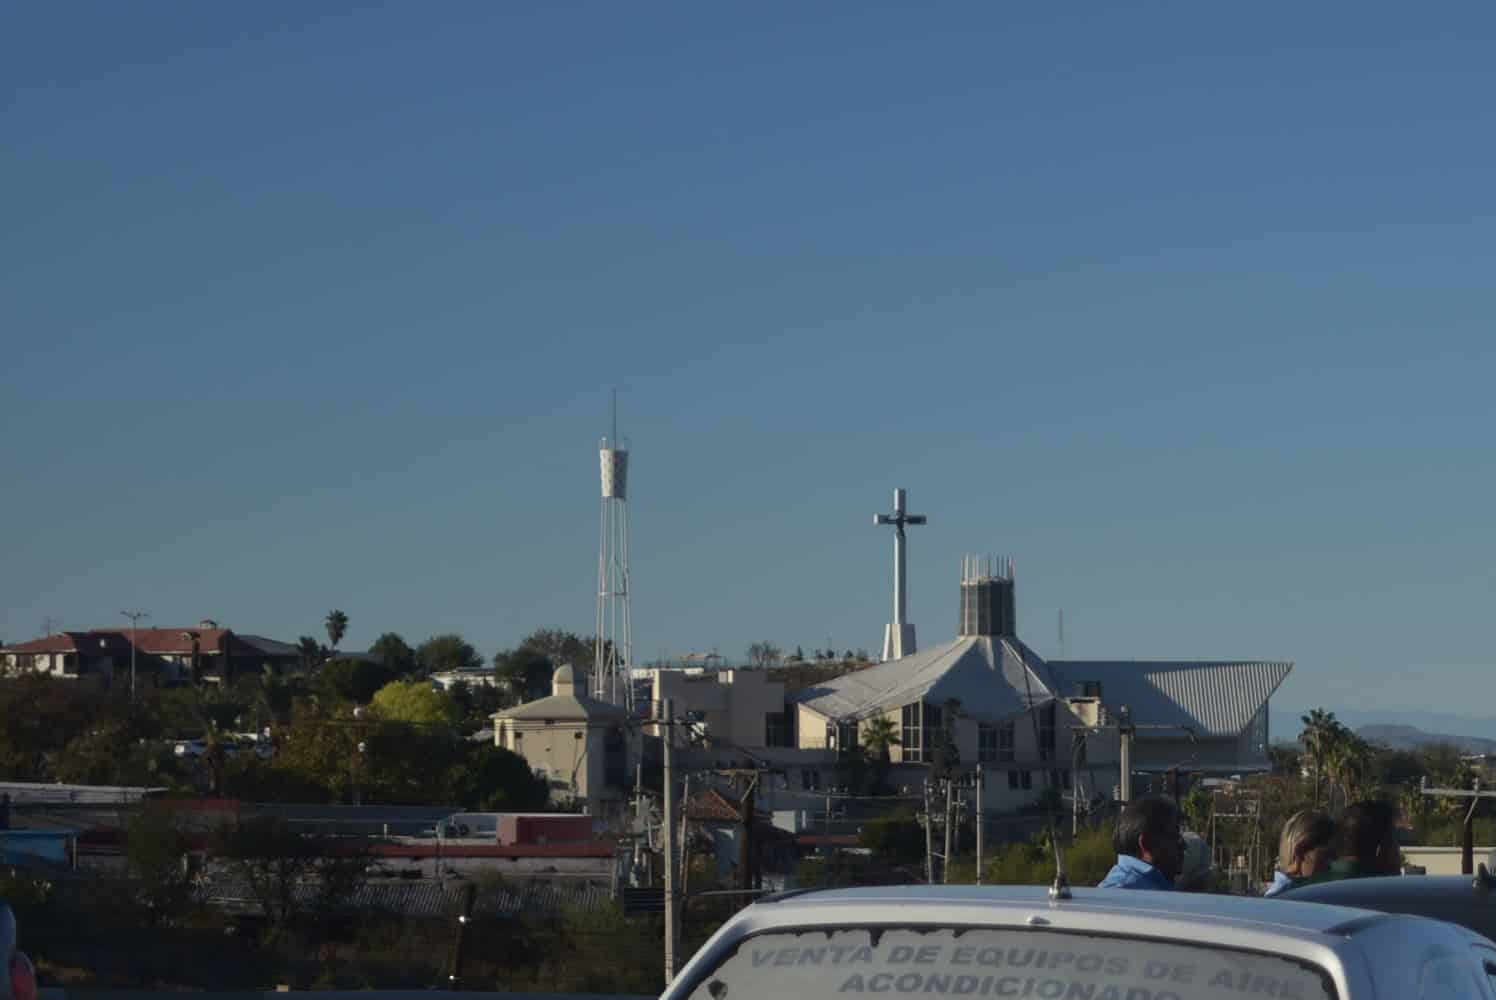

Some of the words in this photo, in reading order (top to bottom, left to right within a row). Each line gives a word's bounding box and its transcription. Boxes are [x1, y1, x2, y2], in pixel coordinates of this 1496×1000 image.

[751, 945, 872, 968] VENTA
[886, 944, 943, 964] DE
[949, 946, 1130, 976] EQUIPOS
[1143, 959, 1197, 984] DE
[1207, 967, 1308, 1000] AIRE
